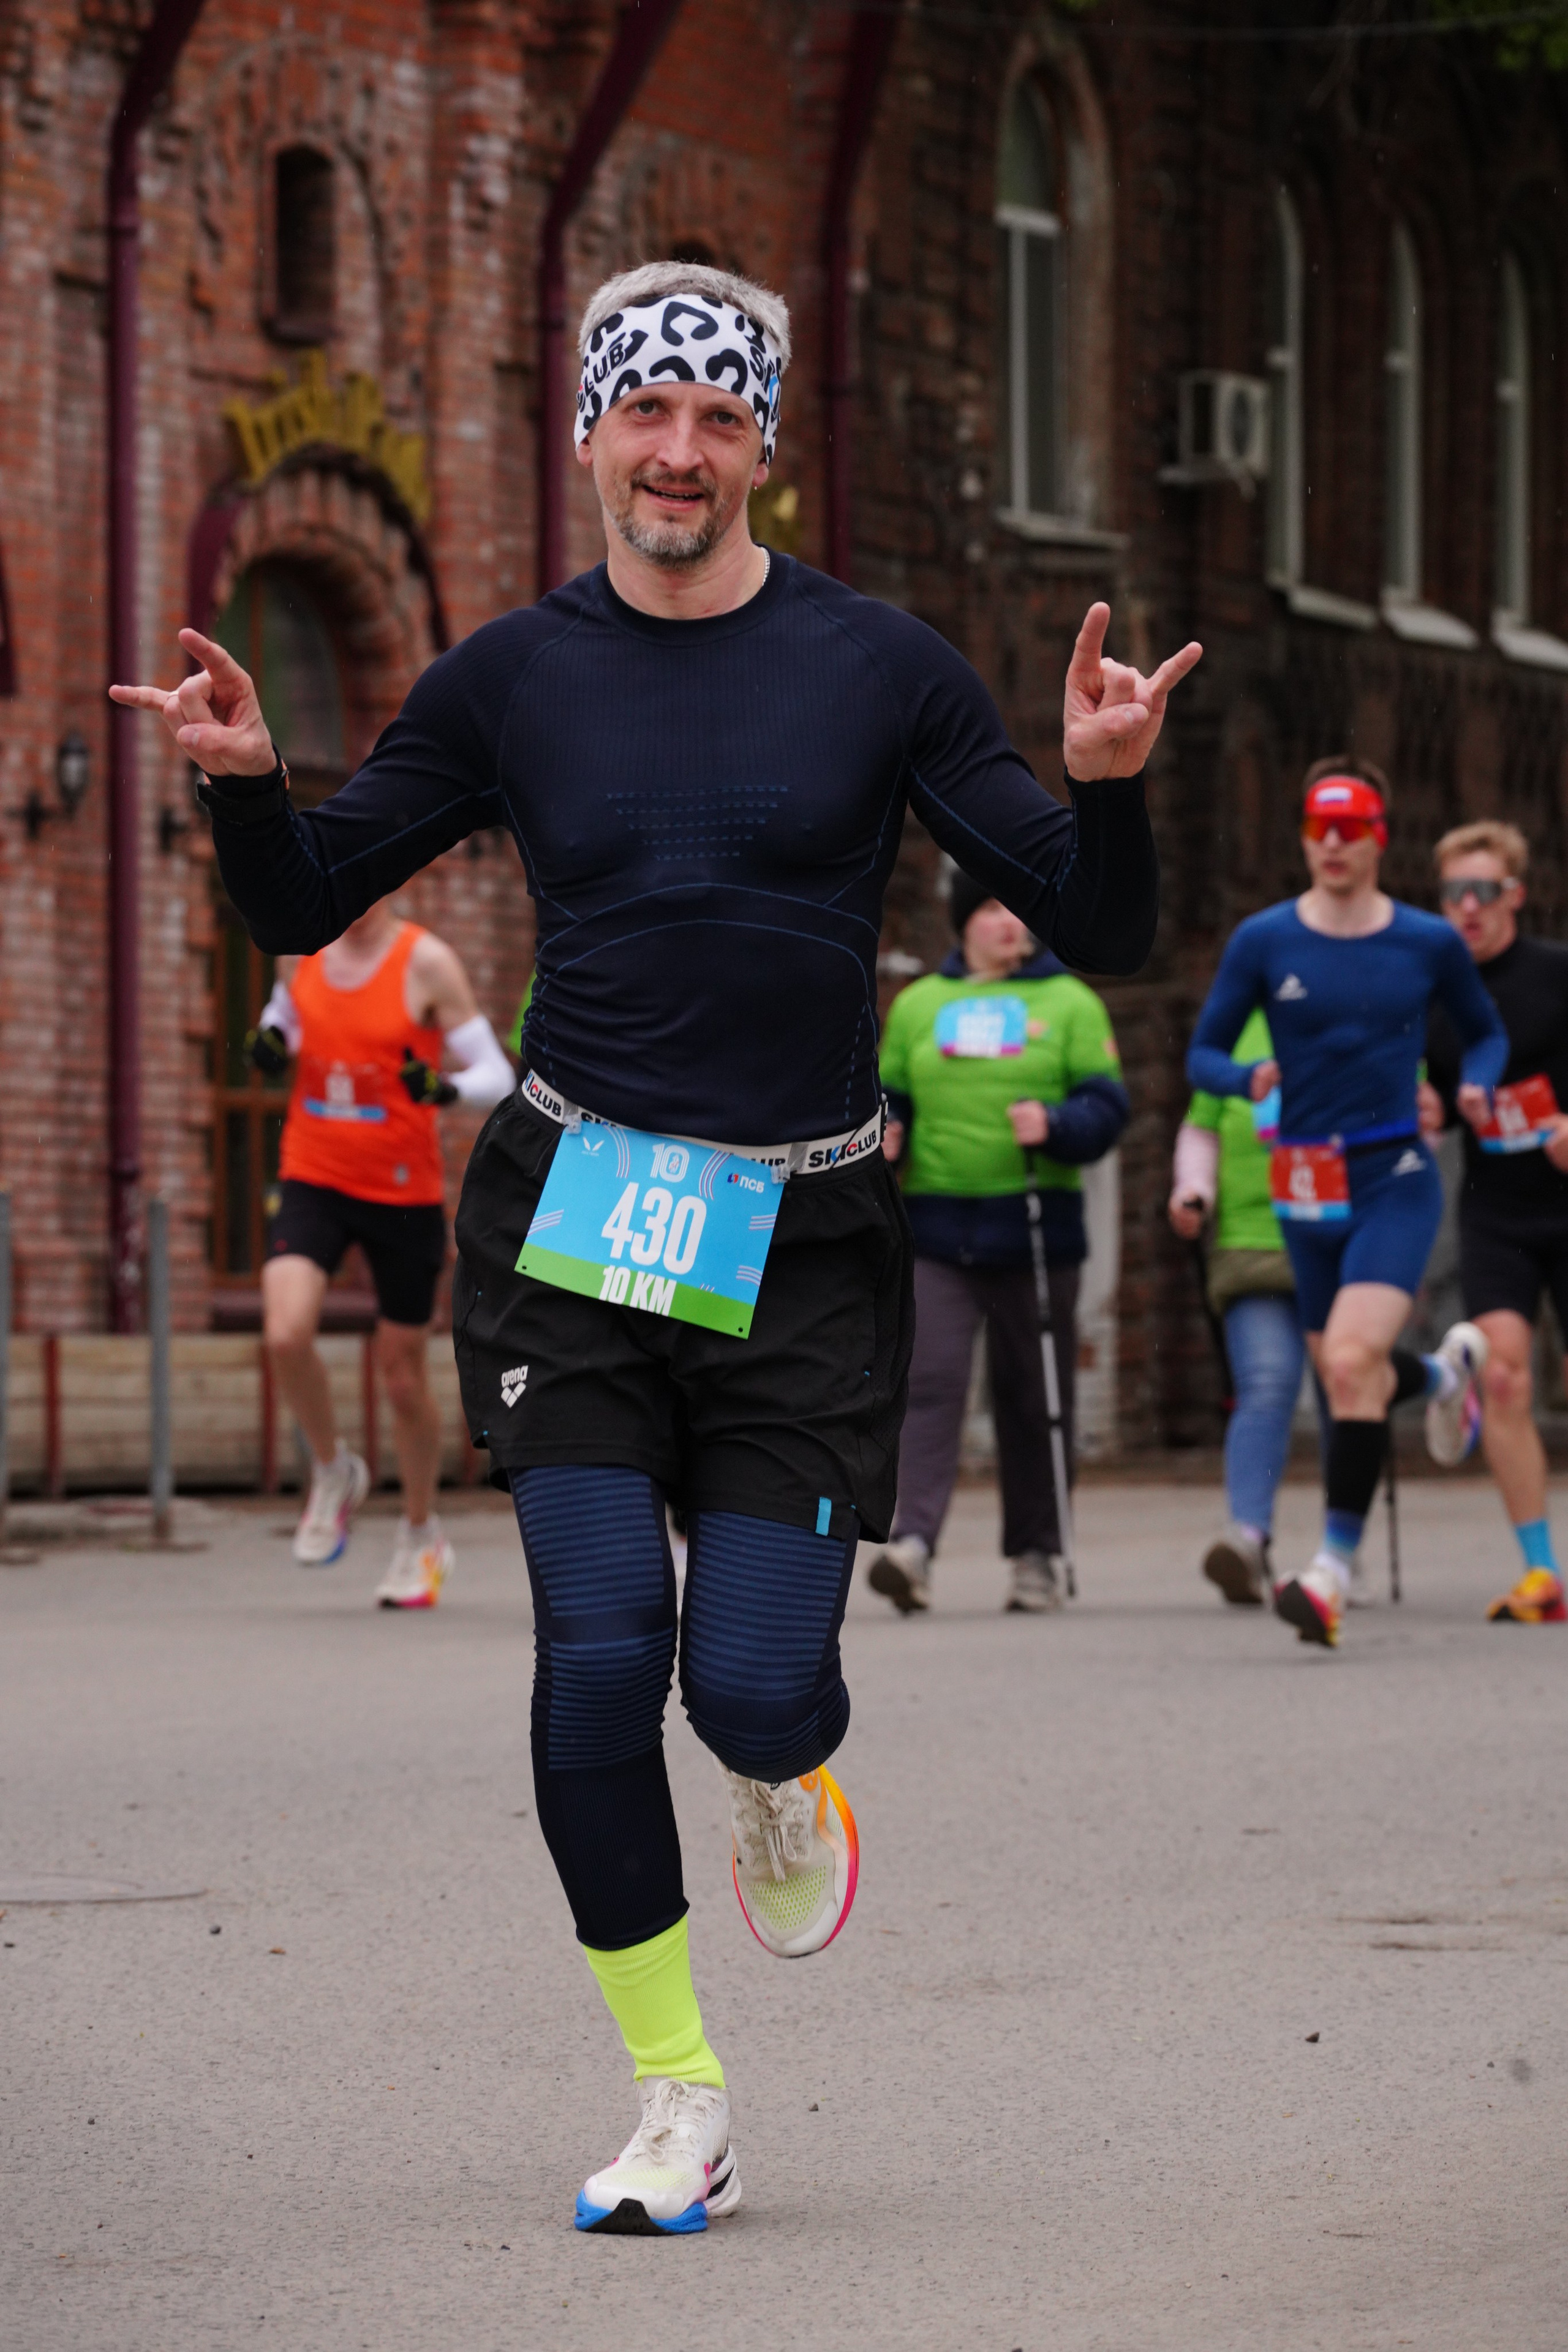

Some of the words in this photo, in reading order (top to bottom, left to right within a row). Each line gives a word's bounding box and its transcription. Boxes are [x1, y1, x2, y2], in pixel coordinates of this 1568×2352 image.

[650, 1143, 690, 1183] 10
[809, 1129, 876, 1167] SKICLUB
[601, 1182, 707, 1275] 430
[598, 1265, 631, 1305] 10
[501, 1365, 529, 1389] arena
